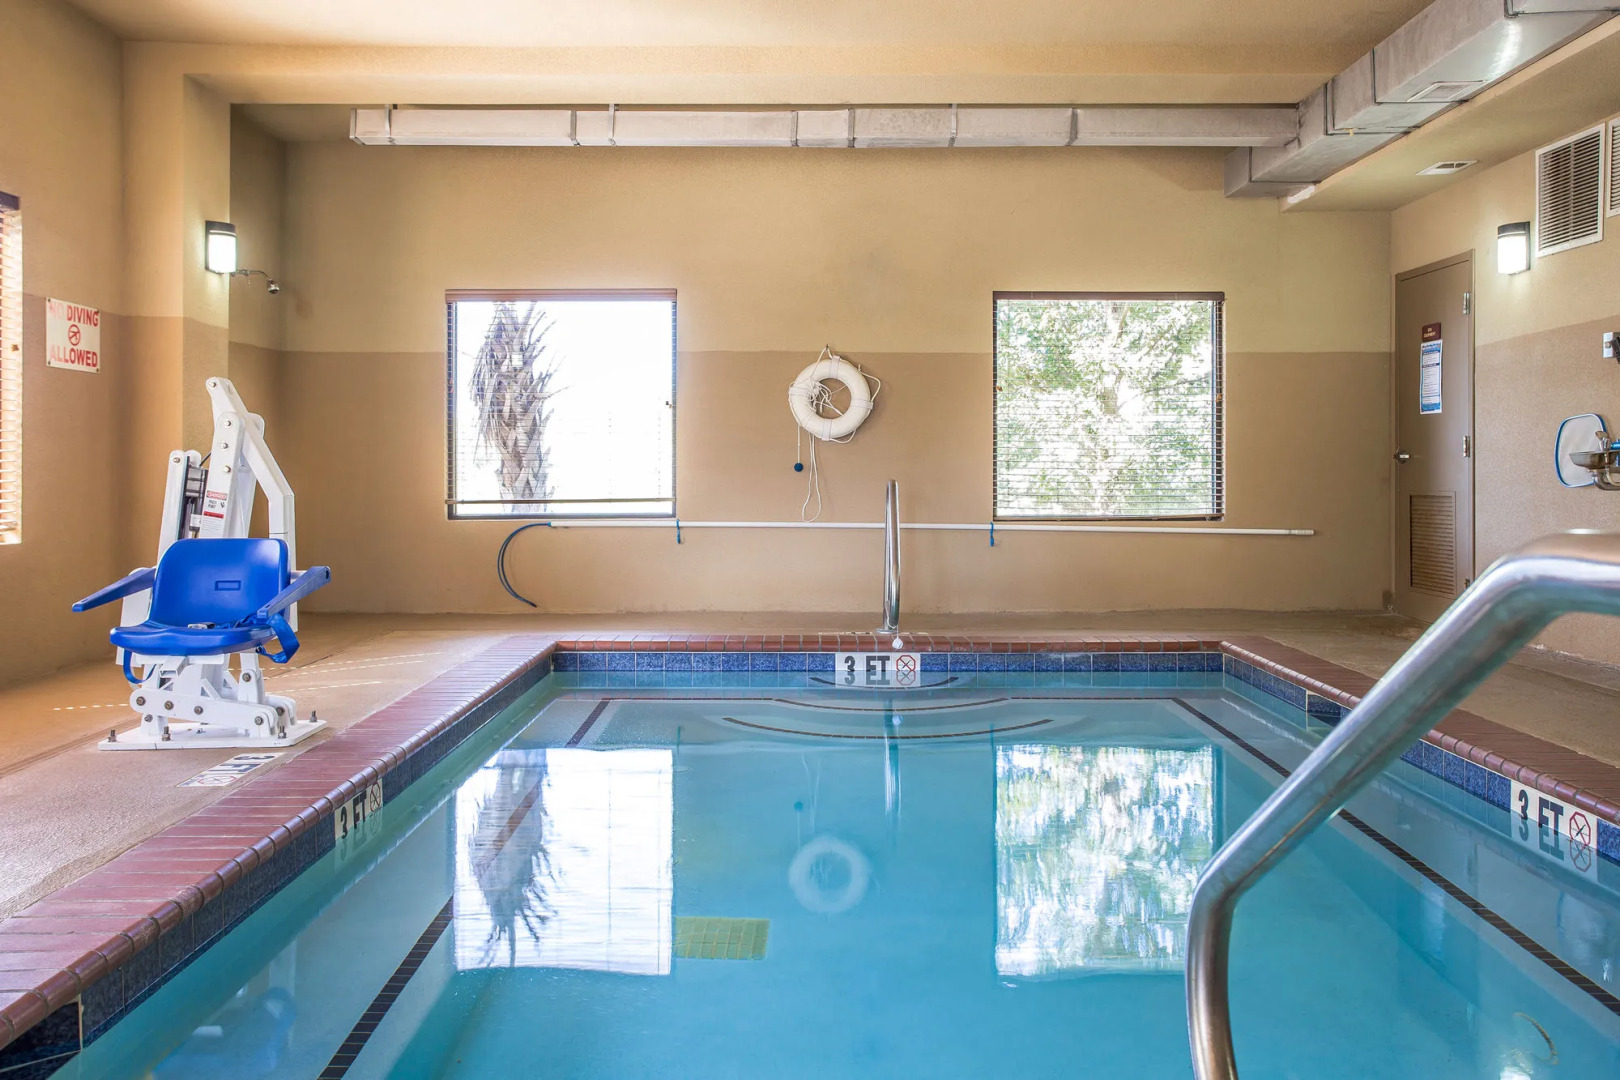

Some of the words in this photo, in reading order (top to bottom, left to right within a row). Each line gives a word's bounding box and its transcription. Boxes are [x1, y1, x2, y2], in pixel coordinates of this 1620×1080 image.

[67, 305, 99, 327] DIVING
[50, 344, 98, 368] ALLOWED
[844, 655, 856, 672] 3
[866, 655, 890, 672] FT
[340, 806, 348, 839] 3
[353, 789, 367, 830] FT
[1518, 789, 1529, 820] 3
[1538, 796, 1564, 836] FT
